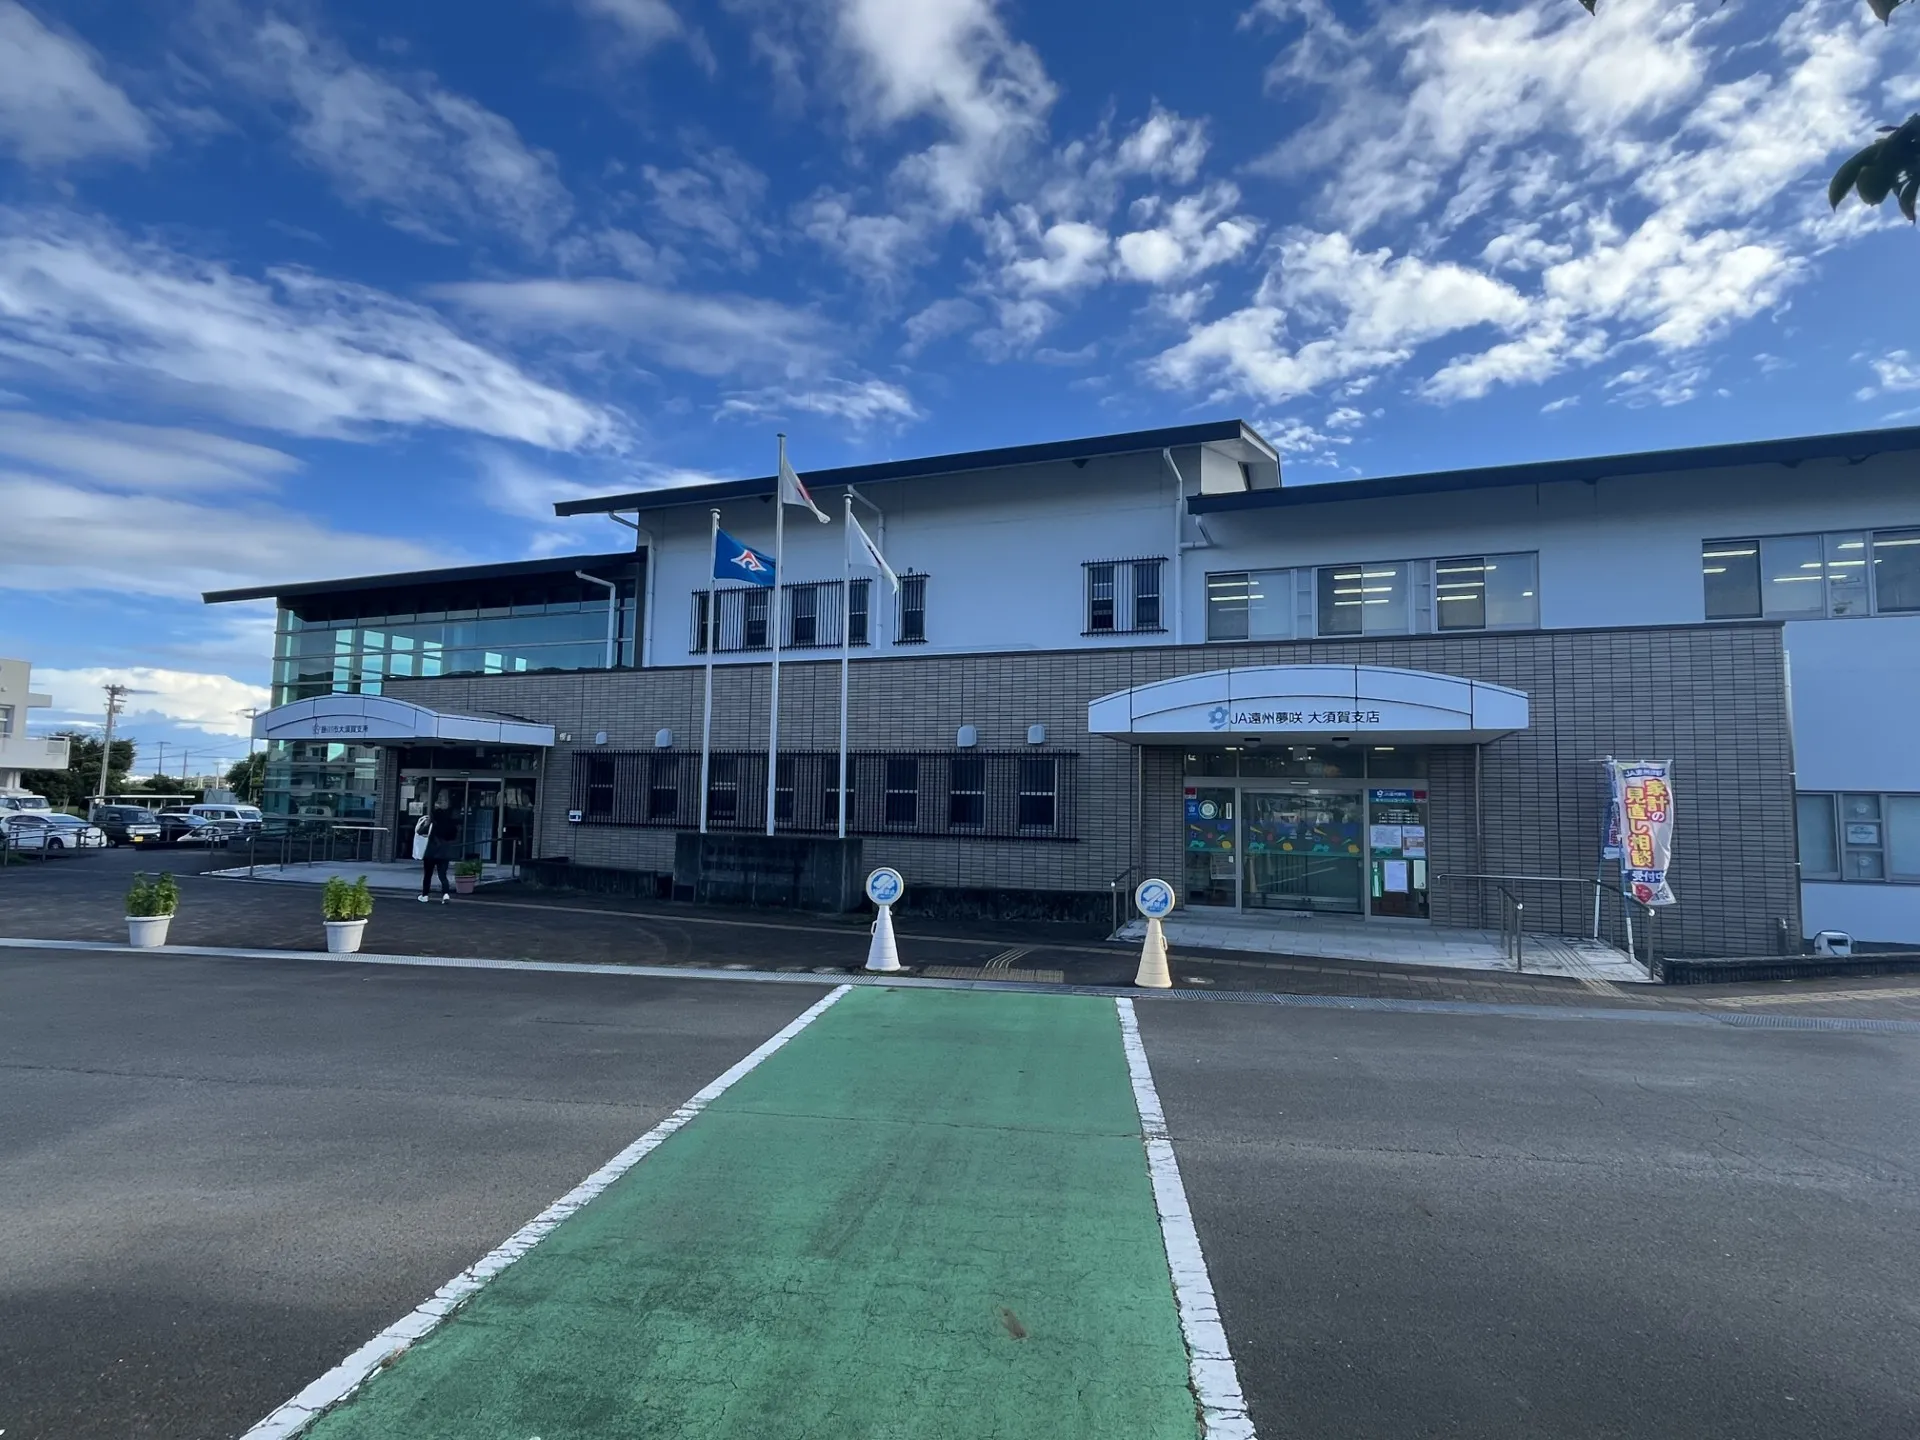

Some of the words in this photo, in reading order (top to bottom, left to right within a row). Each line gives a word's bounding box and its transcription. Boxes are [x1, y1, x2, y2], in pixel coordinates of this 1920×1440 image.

[1230, 711, 1303, 725] JA遠州夢咲
[1307, 711, 1380, 724] 大須賀支店
